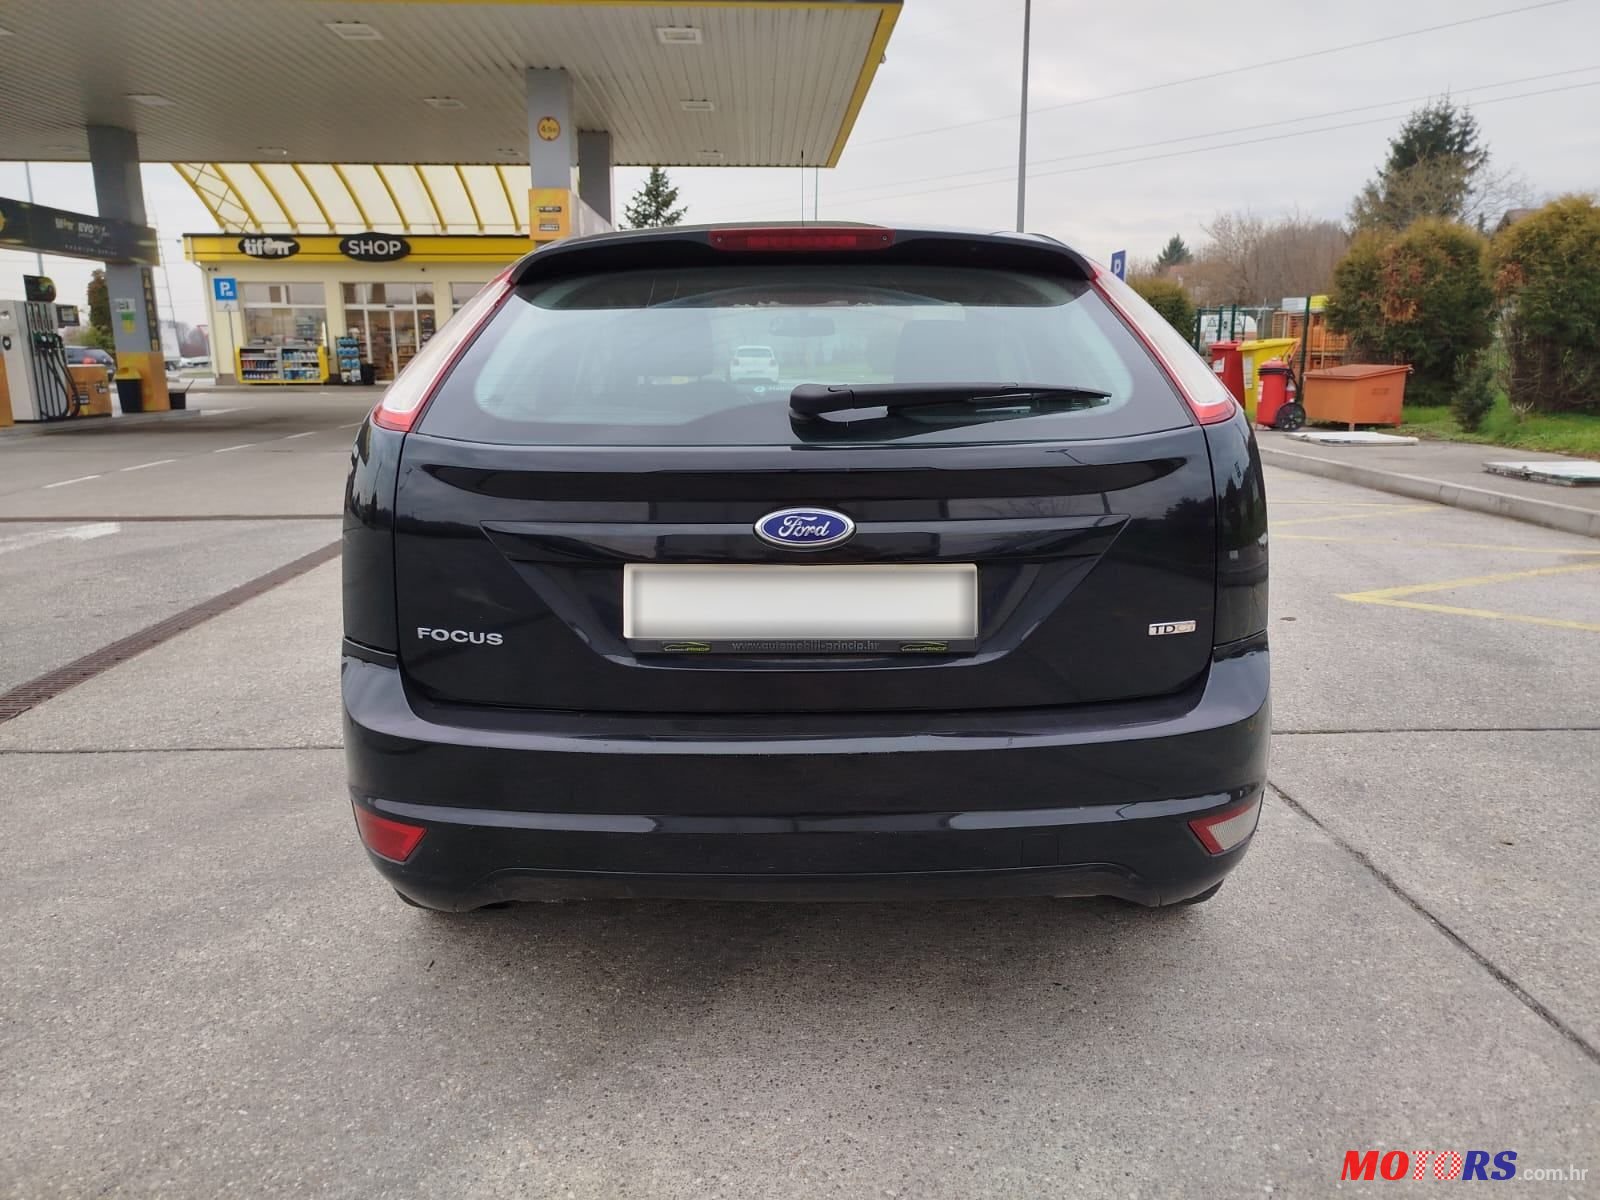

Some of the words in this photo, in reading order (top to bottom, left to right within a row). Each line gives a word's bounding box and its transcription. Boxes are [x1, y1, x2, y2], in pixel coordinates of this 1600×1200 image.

[348, 240, 401, 255] SHOP
[219, 281, 231, 297] P
[778, 515, 831, 537] Ford
[417, 627, 504, 645] FOCUS
